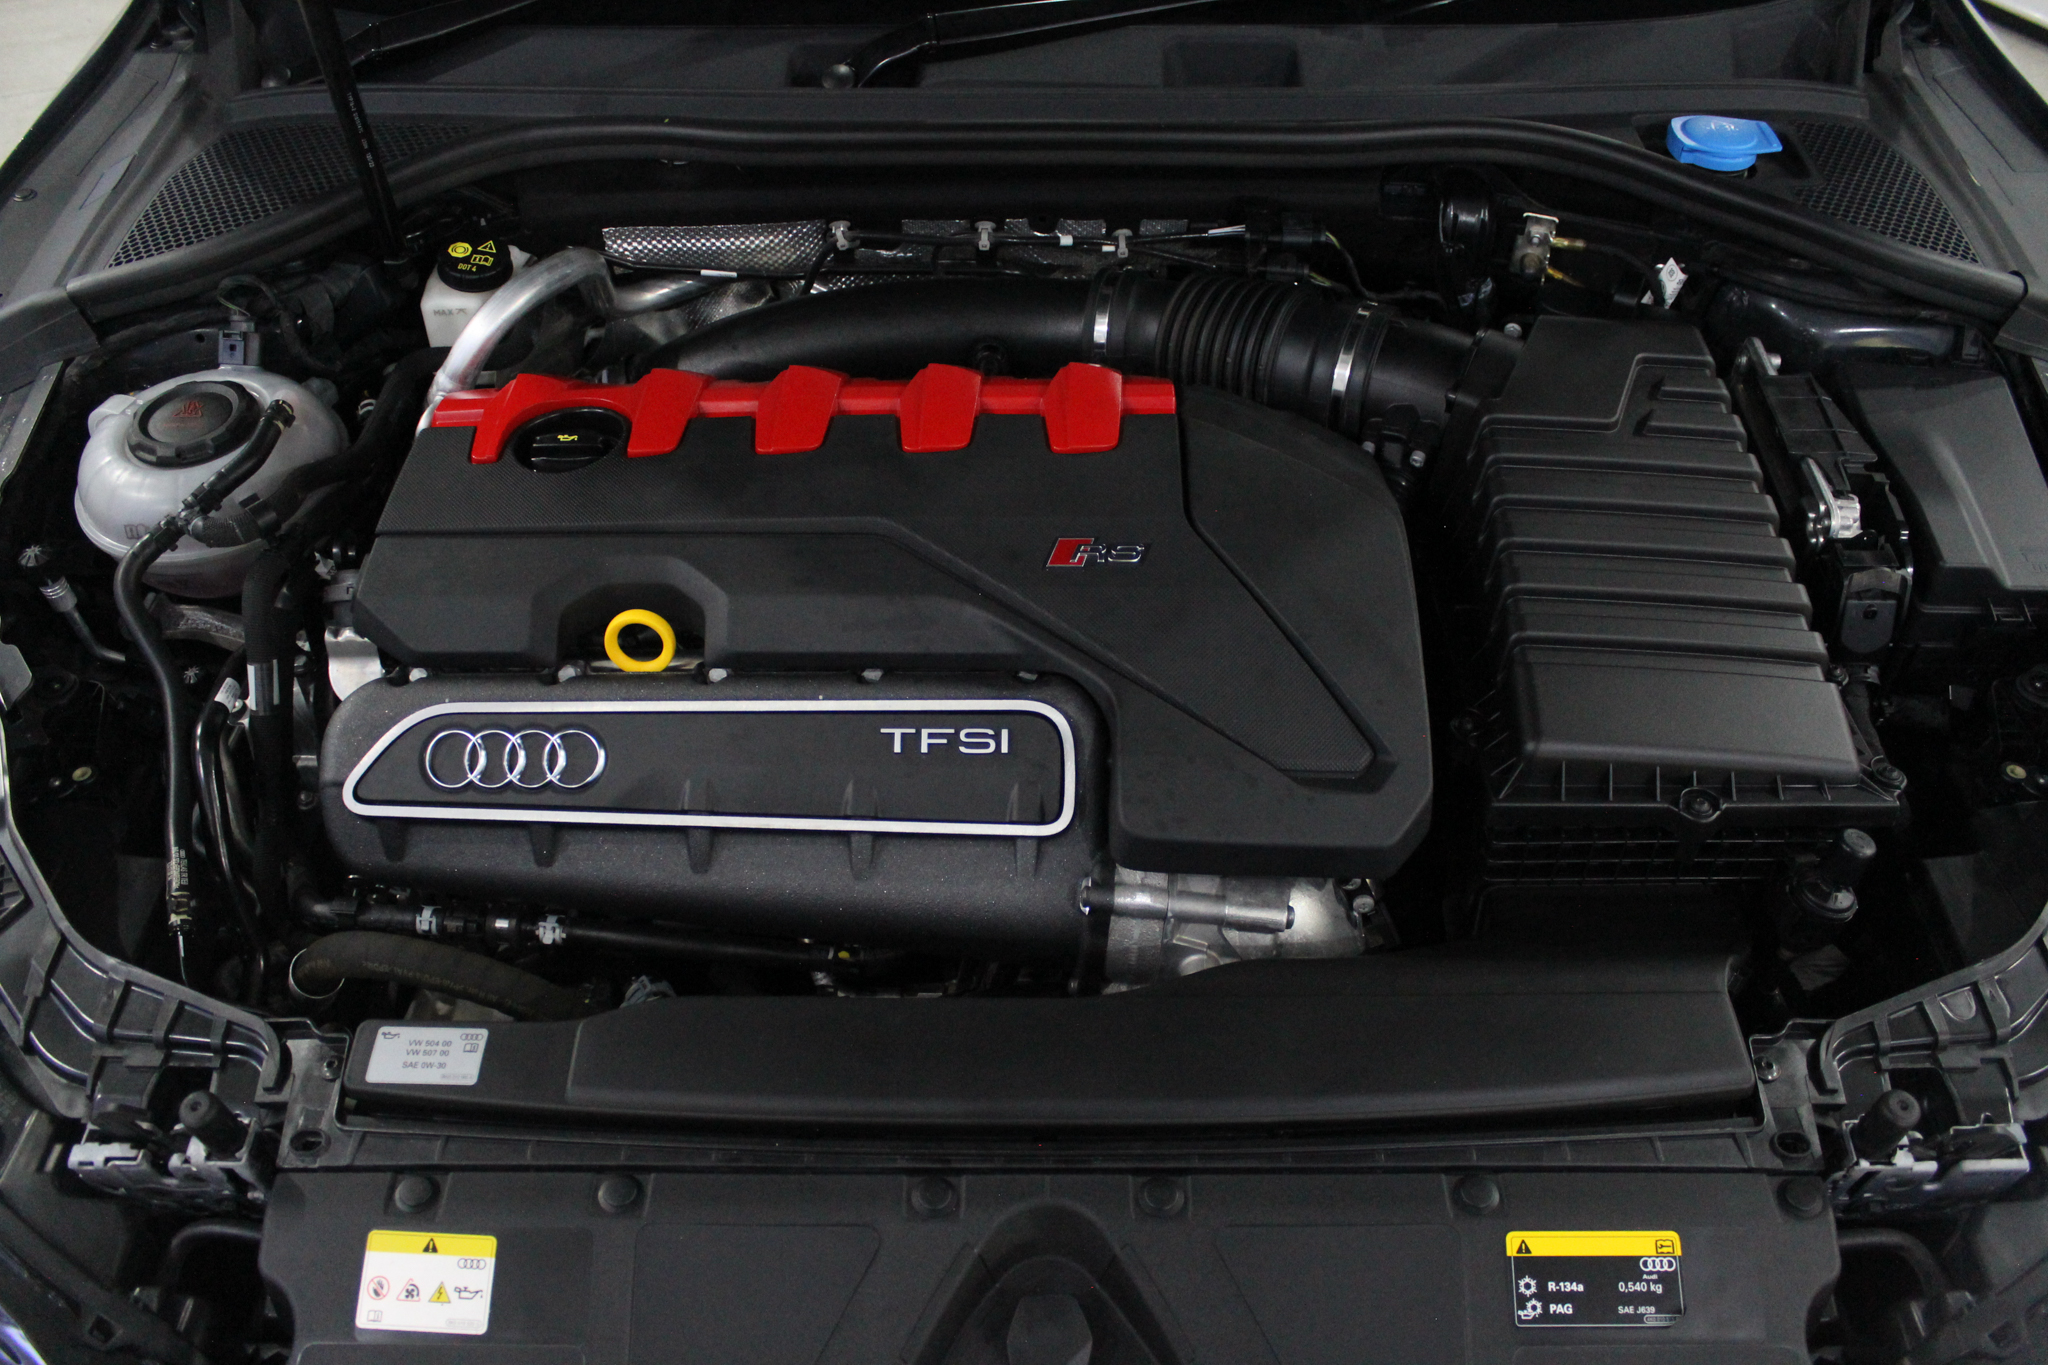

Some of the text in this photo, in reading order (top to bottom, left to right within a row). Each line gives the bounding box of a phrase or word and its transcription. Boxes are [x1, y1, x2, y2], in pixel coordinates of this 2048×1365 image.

[457, 263, 472, 271] DOT
[433, 308, 454, 316] MAX
[1060, 541, 1145, 564] RS
[880, 728, 1009, 754] TFSI
[402, 1061, 419, 1069] SAE
[1548, 1281, 1663, 1294] R-134a 0,540 kg
[1549, 1304, 1655, 1314] PAG SAE J639
